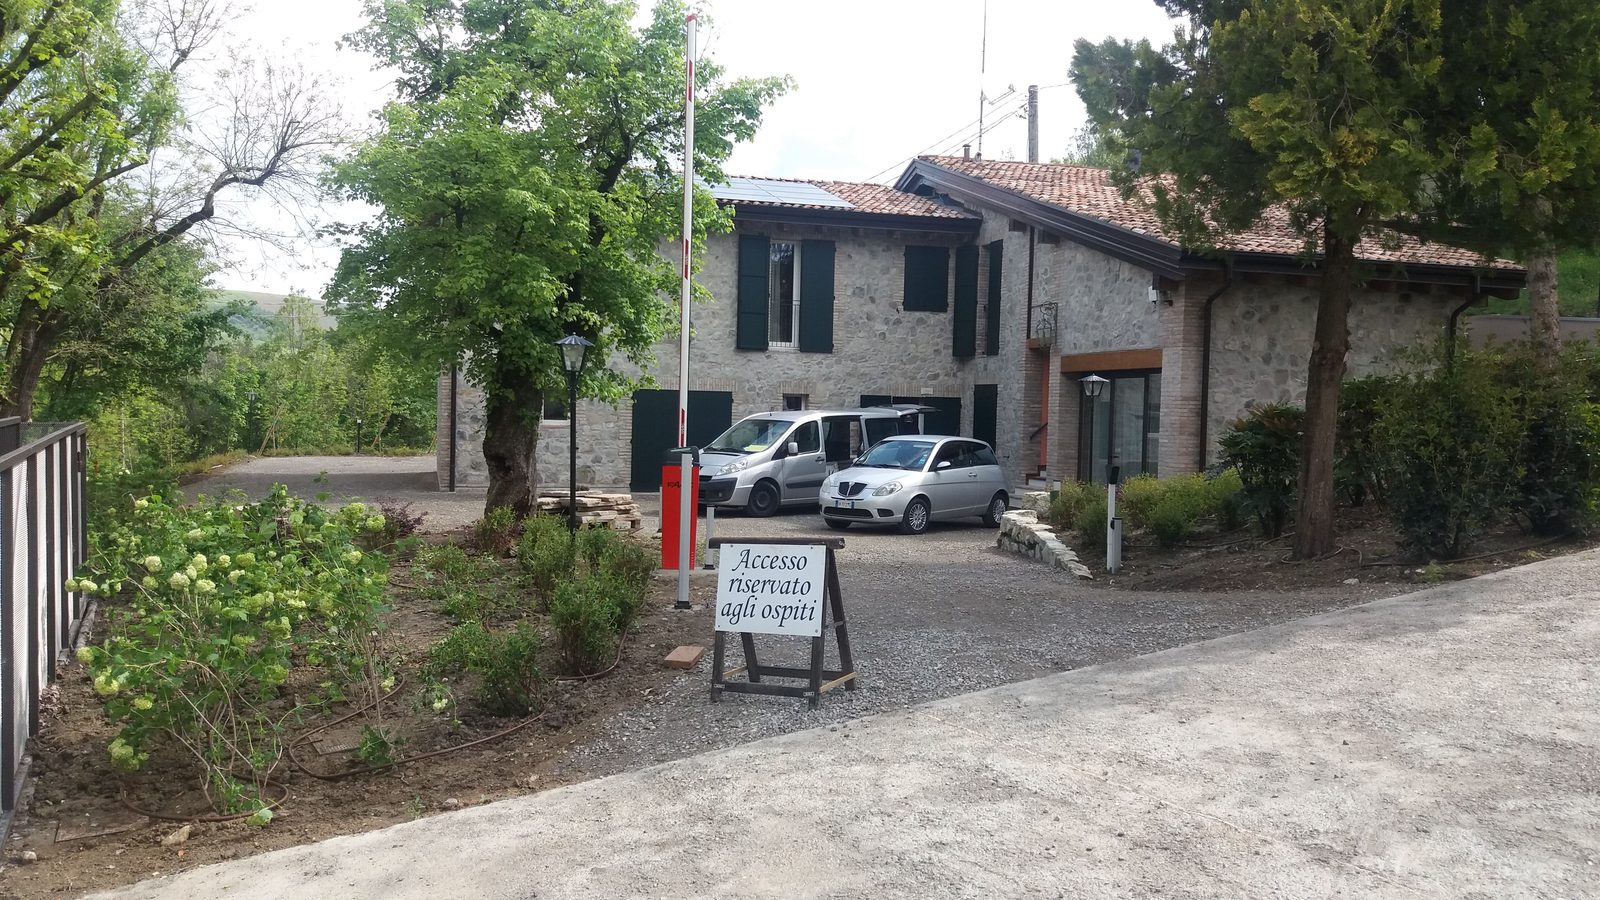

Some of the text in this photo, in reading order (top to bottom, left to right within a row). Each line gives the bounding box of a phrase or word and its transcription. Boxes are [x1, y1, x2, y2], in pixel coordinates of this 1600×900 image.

[731, 548, 808, 572] Accesso
[728, 572, 812, 596] riservato
[720, 595, 817, 628] agli ospiti
